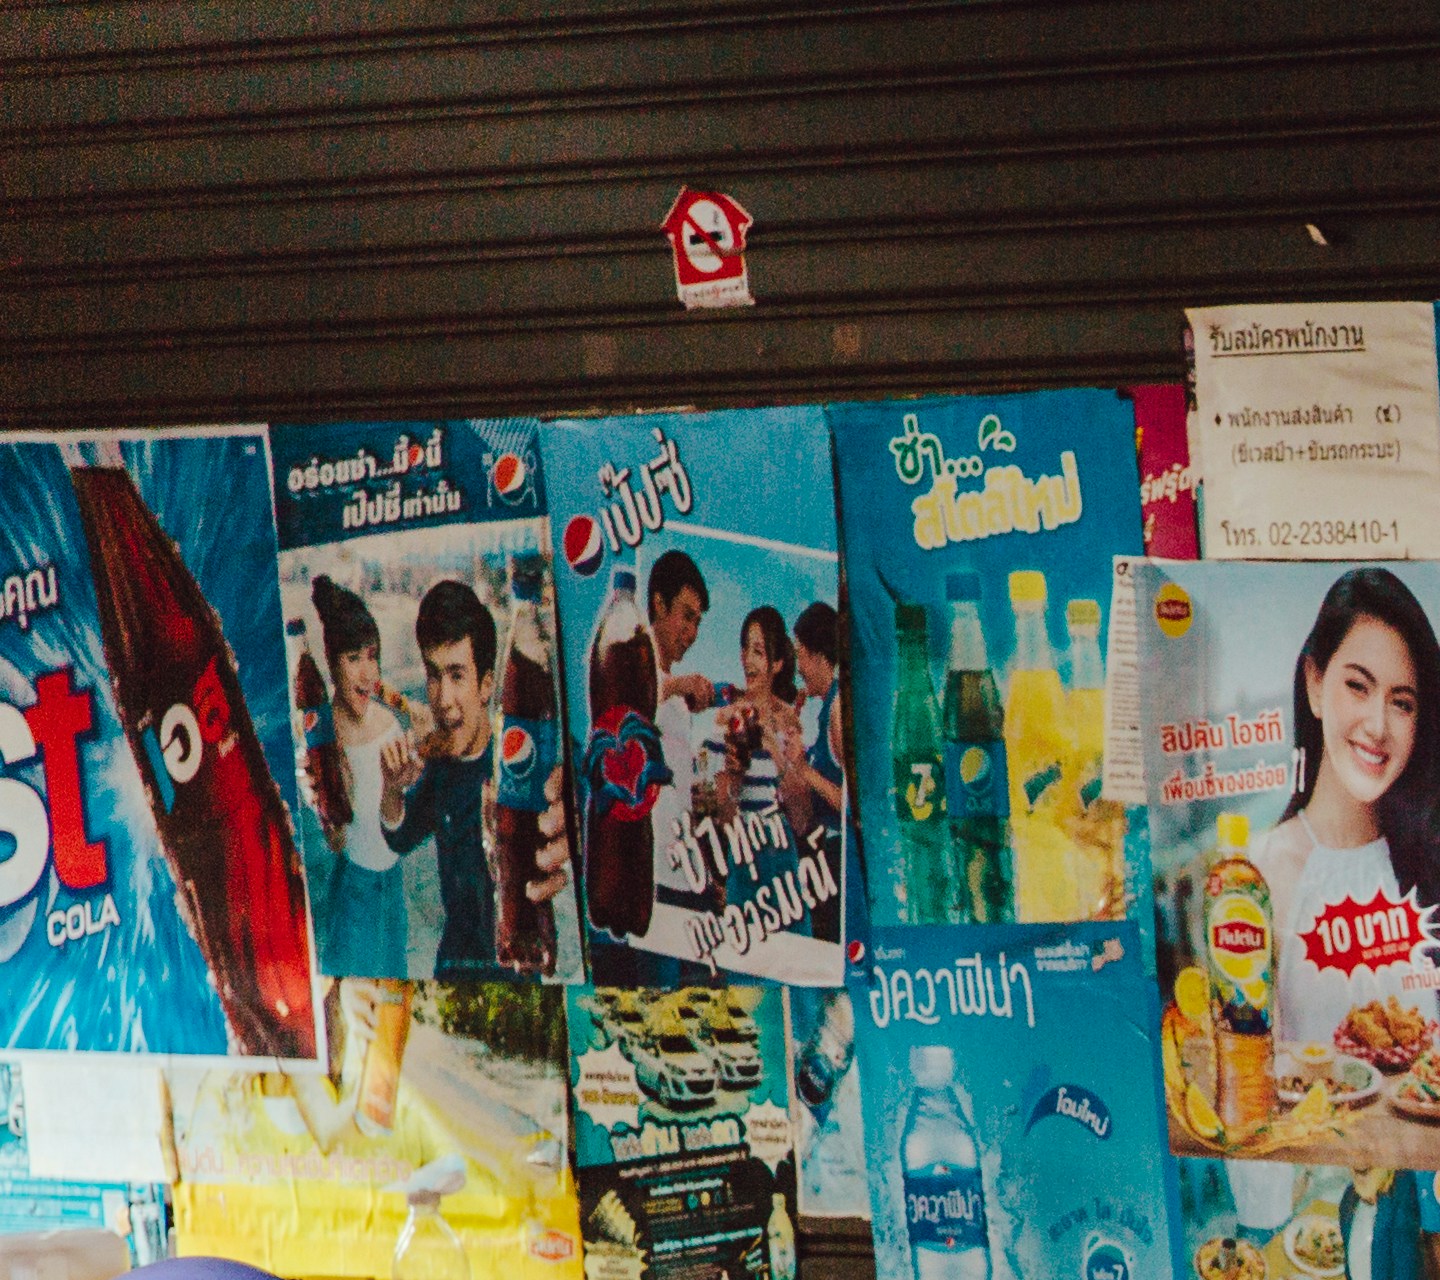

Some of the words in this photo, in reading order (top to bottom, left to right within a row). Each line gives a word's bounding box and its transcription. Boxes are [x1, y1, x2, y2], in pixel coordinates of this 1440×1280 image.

[1209, 320, 1364, 352] รับสมัครพนักงาน
[1268, 519, 1400, 546] 02-2338410-1
[1160, 719, 1224, 753] ลิปตัน
[1227, 712, 1283, 746] ไอซ์ที
[47, 893, 120, 946] COLA
[1316, 915, 1351, 957] 10
[1354, 906, 1411, 949] บาท
